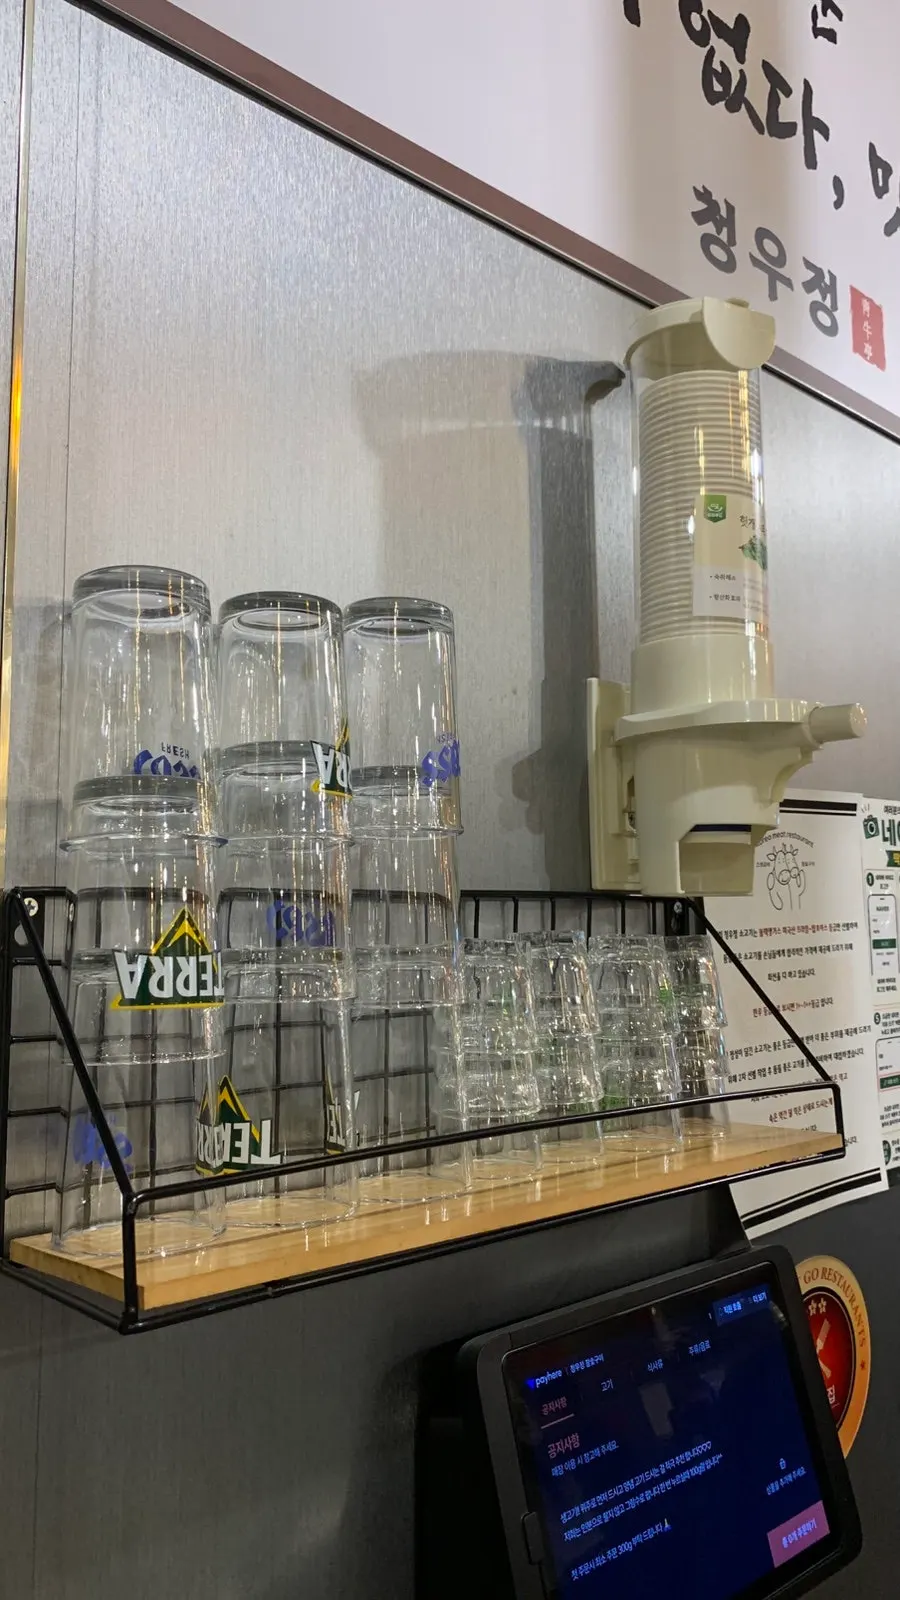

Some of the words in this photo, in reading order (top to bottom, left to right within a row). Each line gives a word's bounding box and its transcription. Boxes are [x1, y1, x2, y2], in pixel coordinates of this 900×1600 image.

[691, 185, 839, 338] 청우정
[114, 951, 225, 999] TERRA
[803, 1267, 820, 1285] GO
[820, 1266, 866, 1348] RESTAURANTS
[535, 1369, 562, 1388] payhere
[600, 1378, 614, 1392] 고기
[542, 1396, 568, 1416] 공지사항
[547, 1432, 580, 1460] 공지사항
